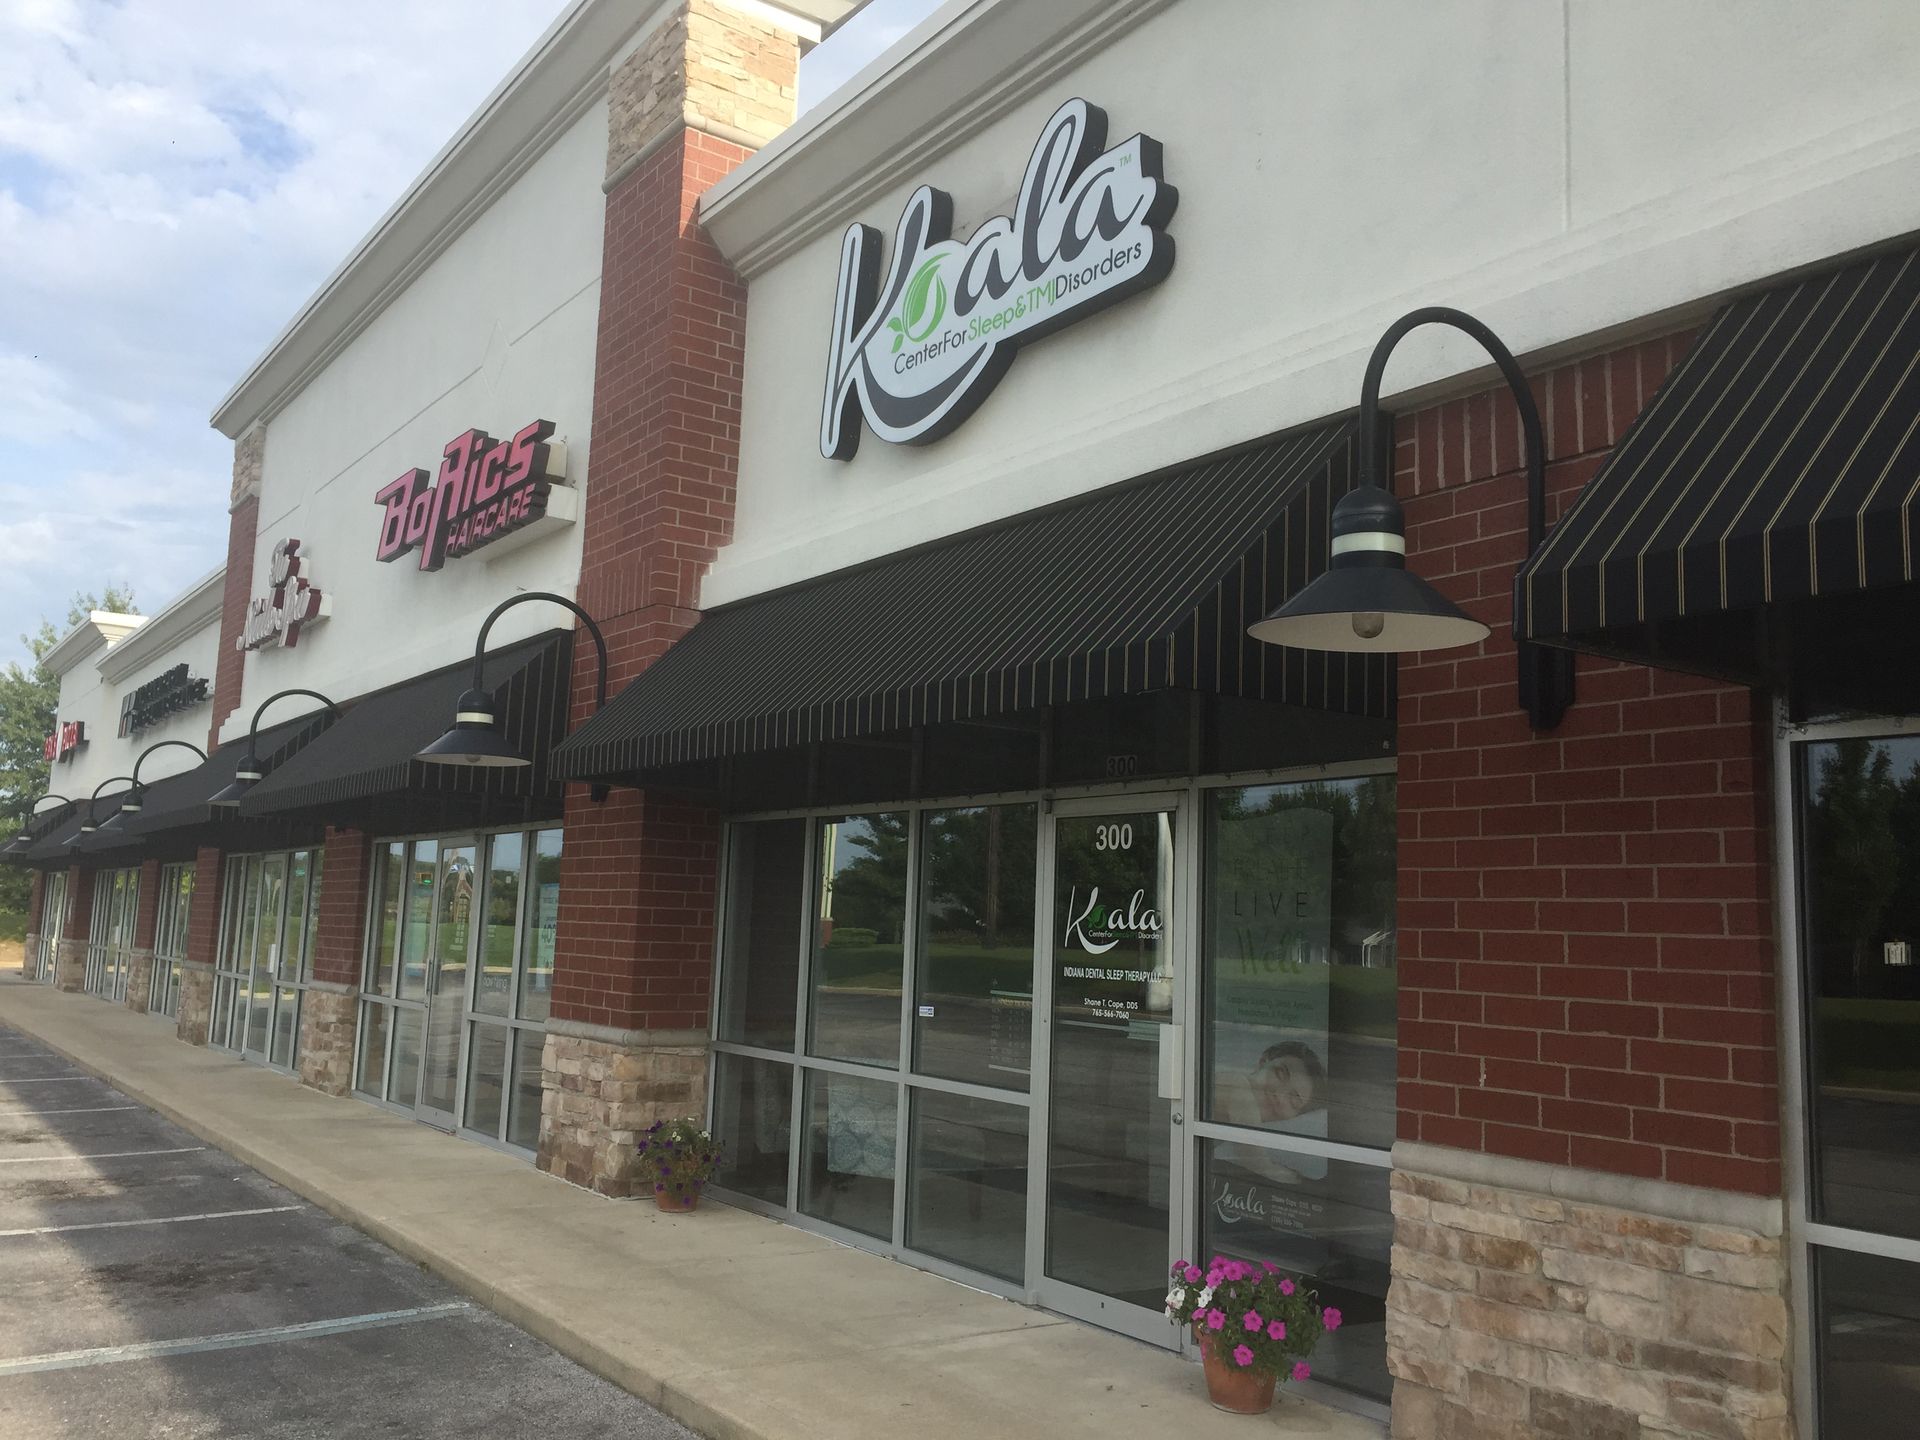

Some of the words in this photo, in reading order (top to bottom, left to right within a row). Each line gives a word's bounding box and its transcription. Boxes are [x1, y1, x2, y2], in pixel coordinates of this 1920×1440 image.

[827, 114, 1145, 445] Koala
[1107, 756, 1136, 777] 300
[1095, 823, 1133, 851] 300
[1234, 890, 1309, 918] LIVE
[1064, 885, 1164, 955] Koala
[1064, 967, 1085, 978] INDIANA
[1086, 968, 1105, 979] DENTAL
[1106, 969, 1123, 980] SLEEP
[1084, 998, 1101, 1006] Shane
[1092, 1009, 1129, 1019] 765-566-7060
